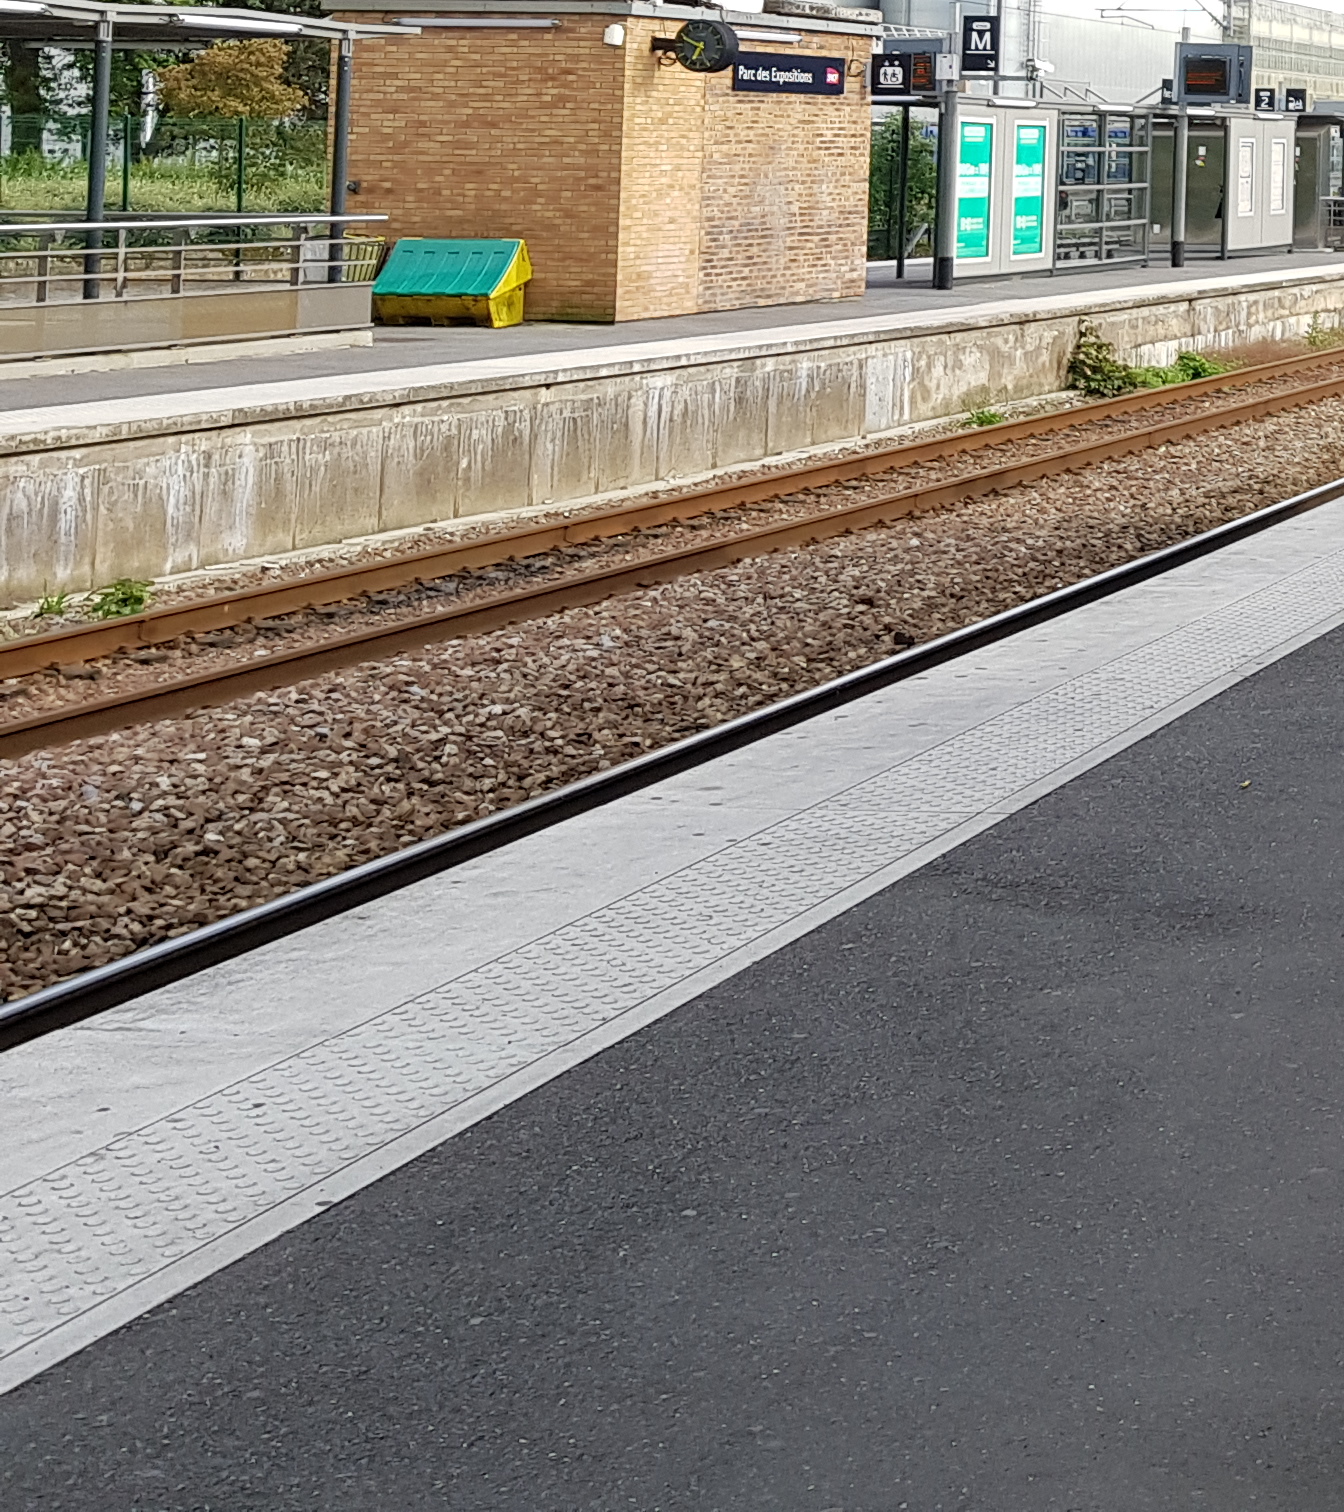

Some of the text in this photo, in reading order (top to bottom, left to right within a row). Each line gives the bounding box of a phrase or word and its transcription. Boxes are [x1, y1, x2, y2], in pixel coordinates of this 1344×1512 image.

[971, 31, 991, 50] M
[738, 65, 813, 85] Parc des Expositions
[1260, 96, 1269, 107] 2
